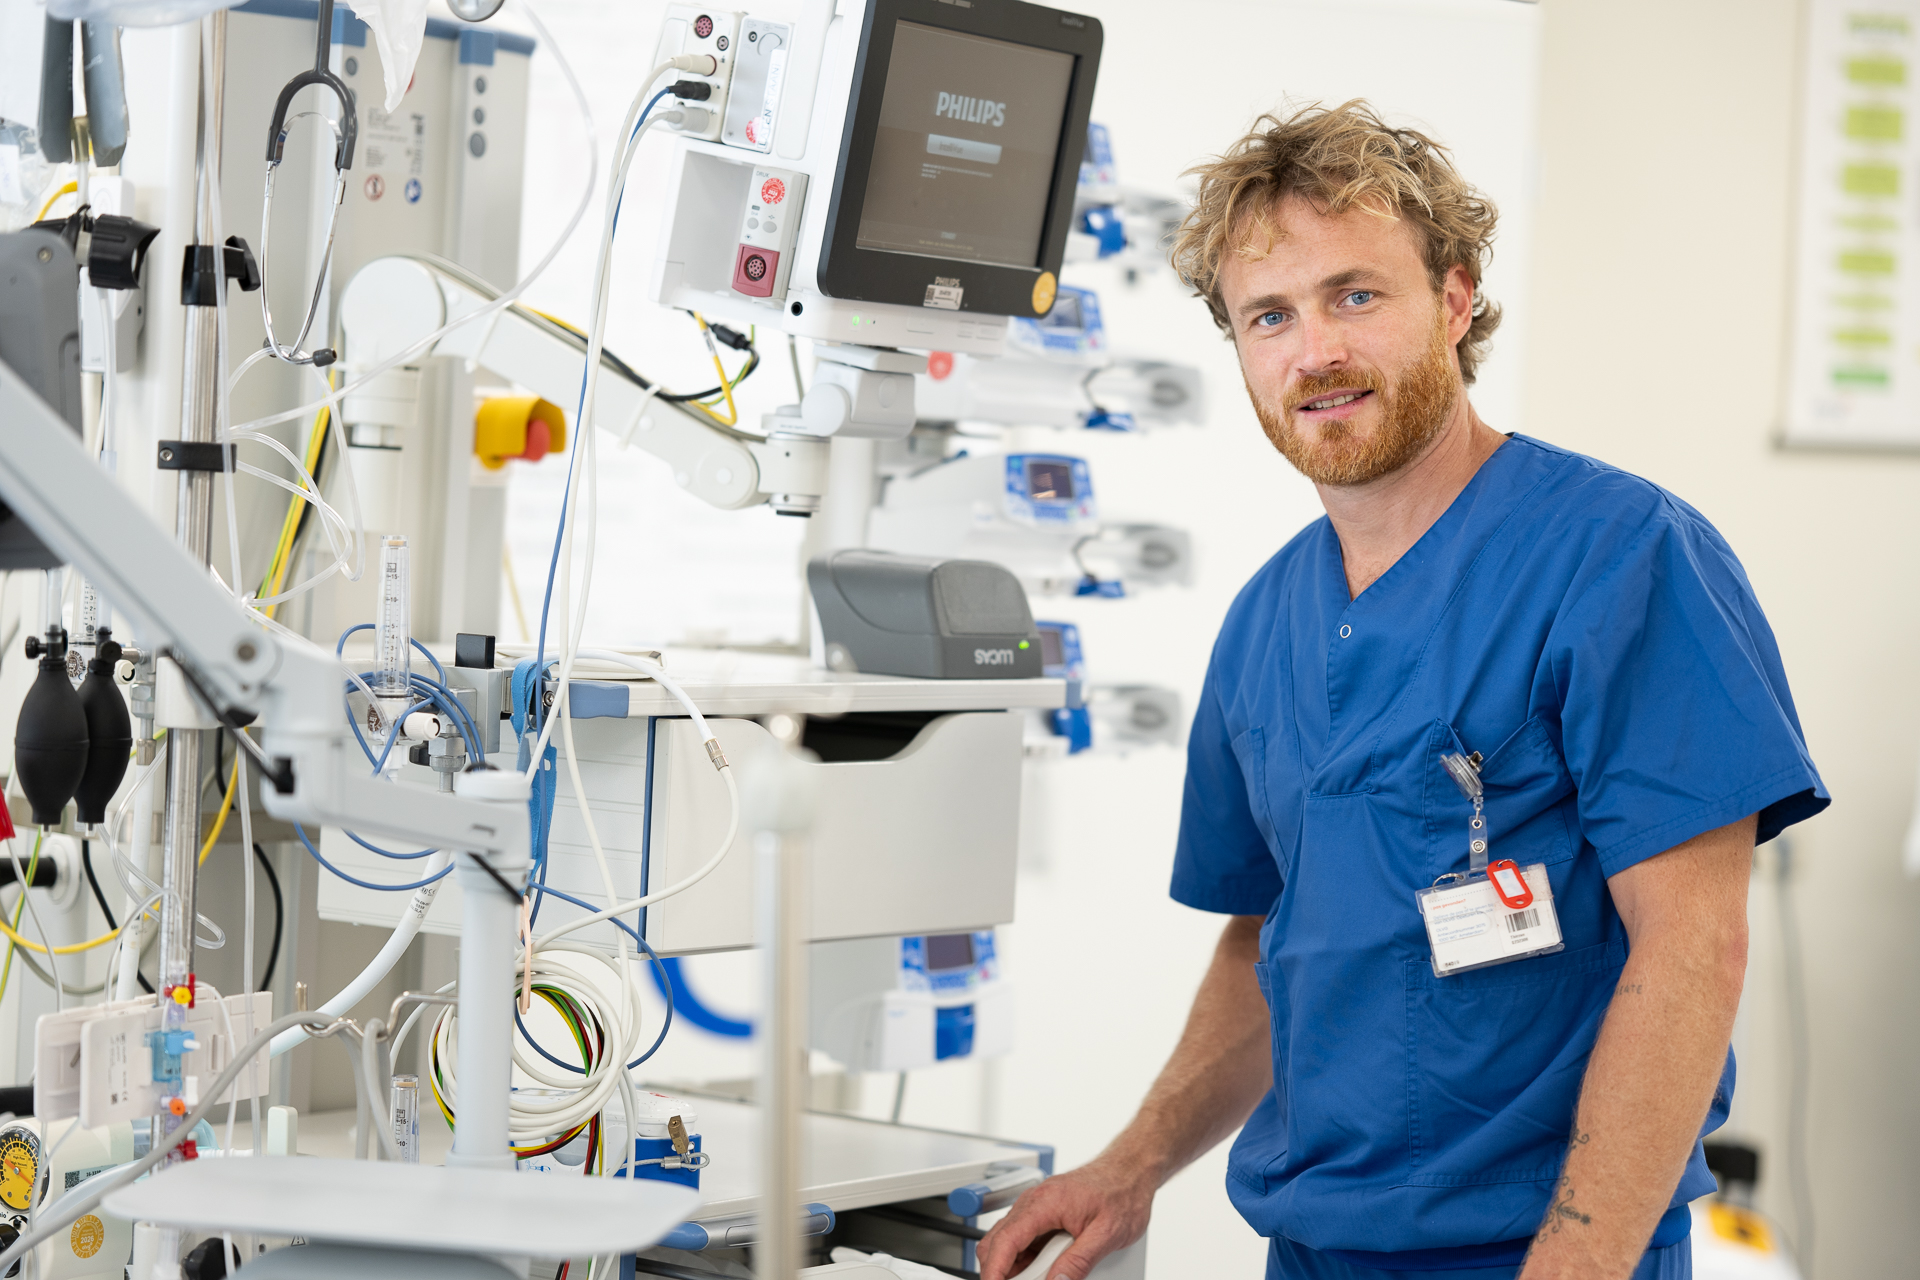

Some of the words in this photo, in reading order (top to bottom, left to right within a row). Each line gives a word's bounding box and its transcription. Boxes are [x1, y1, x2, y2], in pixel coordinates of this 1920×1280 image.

[936, 91, 1006, 127] PHILIPS
[756, 170, 770, 178] DRUK
[934, 276, 960, 288] PHILIPS
[974, 648, 1014, 665] LUCAS
[80, 1235, 94, 1244] 2026
